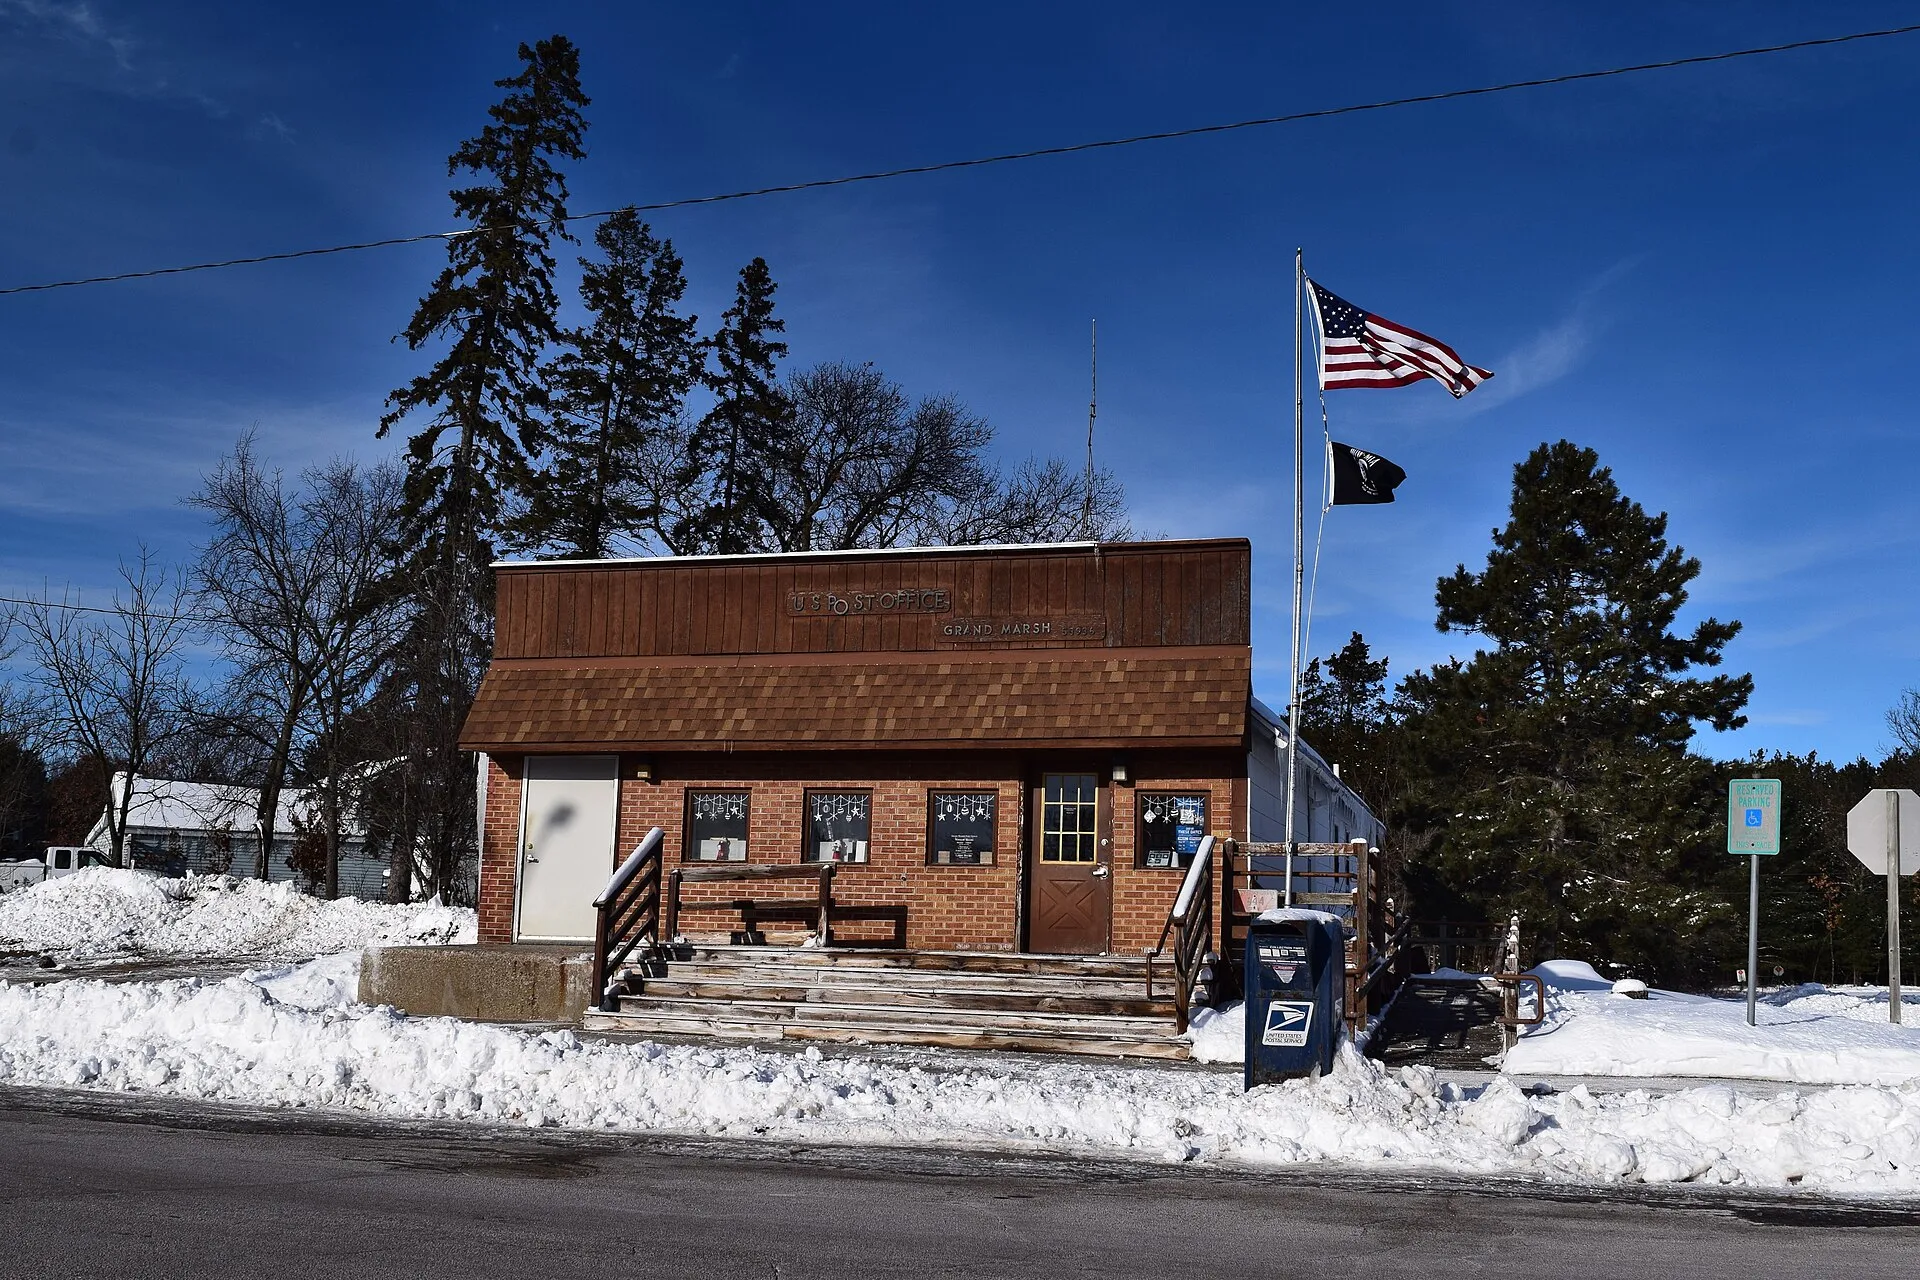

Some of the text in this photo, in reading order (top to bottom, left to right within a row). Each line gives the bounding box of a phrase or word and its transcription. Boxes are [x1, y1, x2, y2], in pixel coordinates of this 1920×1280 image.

[793, 592, 945, 615] U S POST OFFICE
[943, 622, 1096, 636] GRAND MARSH 53936
[1736, 785, 1774, 795] RESERVED
[1738, 797, 1771, 807] PARKING
